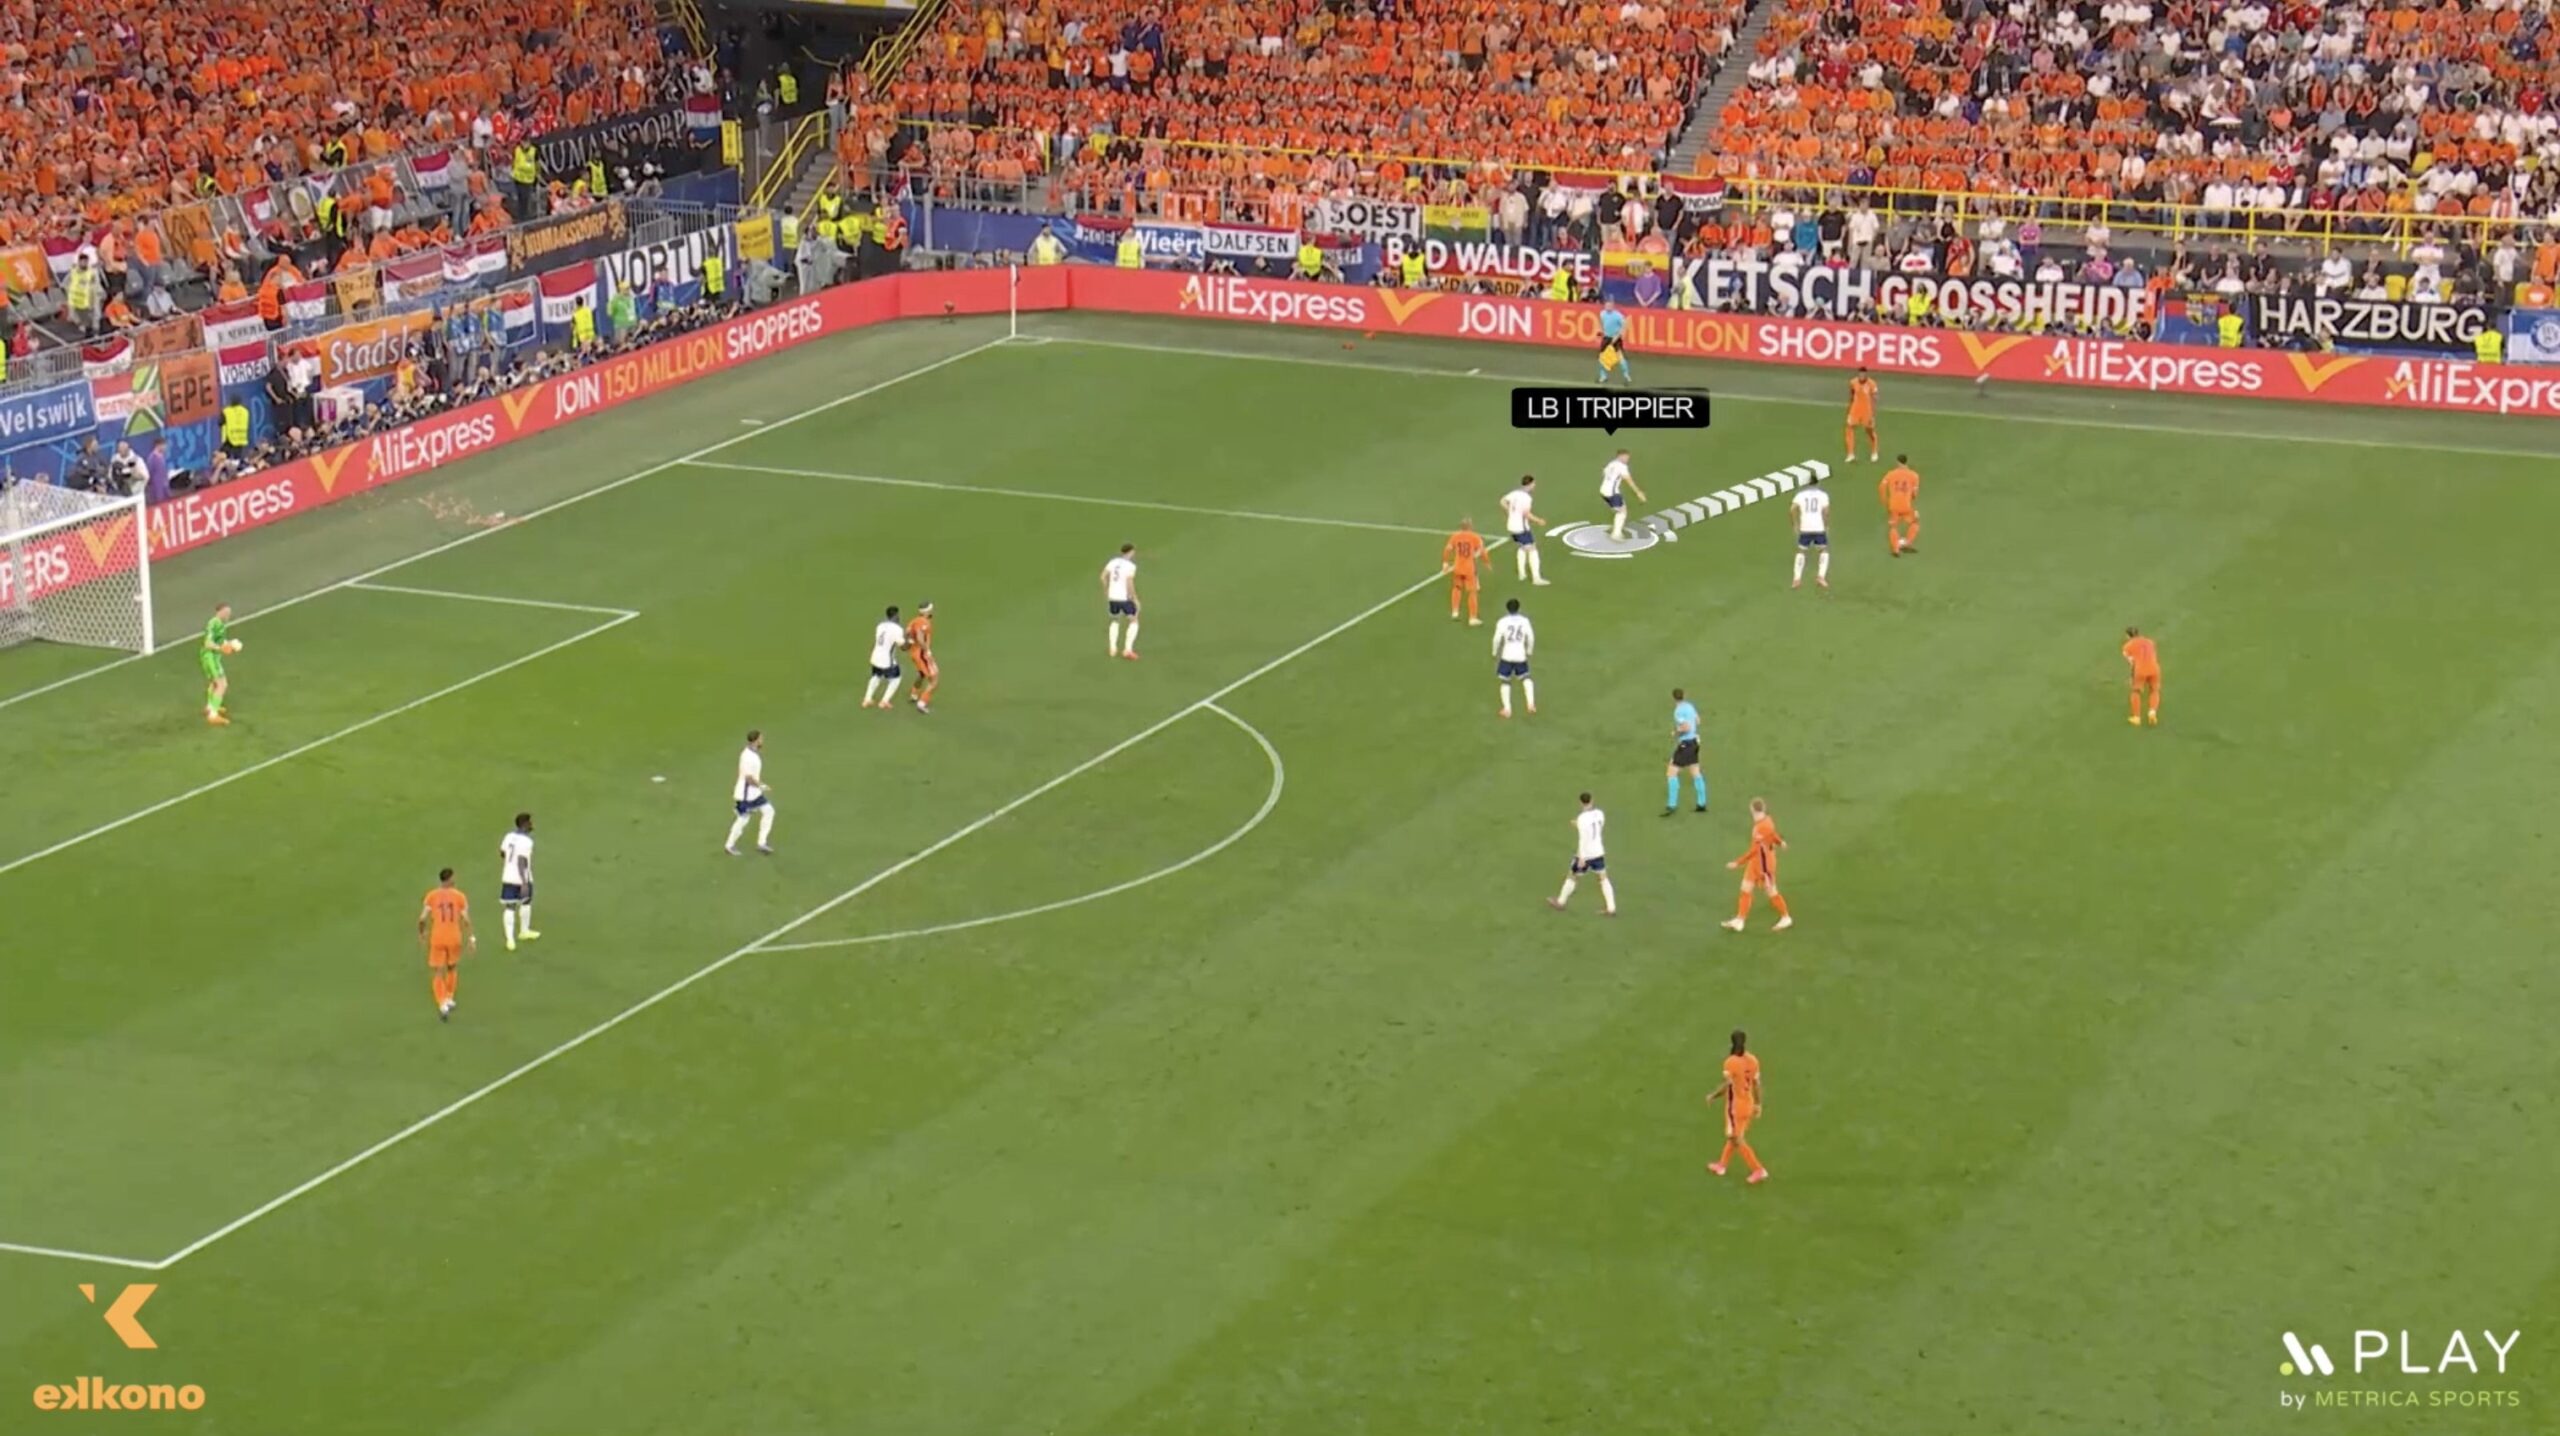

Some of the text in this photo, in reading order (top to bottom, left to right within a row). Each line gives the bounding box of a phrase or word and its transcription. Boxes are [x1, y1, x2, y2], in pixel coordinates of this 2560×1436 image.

[1331, 202, 1416, 233] SOEST
[1208, 231, 1290, 254] DALFSEN
[1178, 276, 1366, 323] AliExpress
[1458, 301, 1532, 336] JOIN
[1542, 311, 1597, 341] 150
[1758, 325, 1942, 367] SHOPPERS
[2258, 295, 2487, 344] HARZBURG
[555, 301, 822, 420] JOIN 150 MILLION SHOPPERS
[2044, 339, 2263, 391] AliExpress
[168, 374, 213, 414] EPE
[367, 414, 495, 481] AliExpress
[150, 480, 294, 554] AliExpress
[1804, 498, 1818, 512] 10
[1457, 542, 1470, 557] 18
[1113, 565, 1120, 582] 5
[1507, 626, 1523, 642] 26
[508, 843, 515, 862] 7
[438, 902, 454, 923] 11
